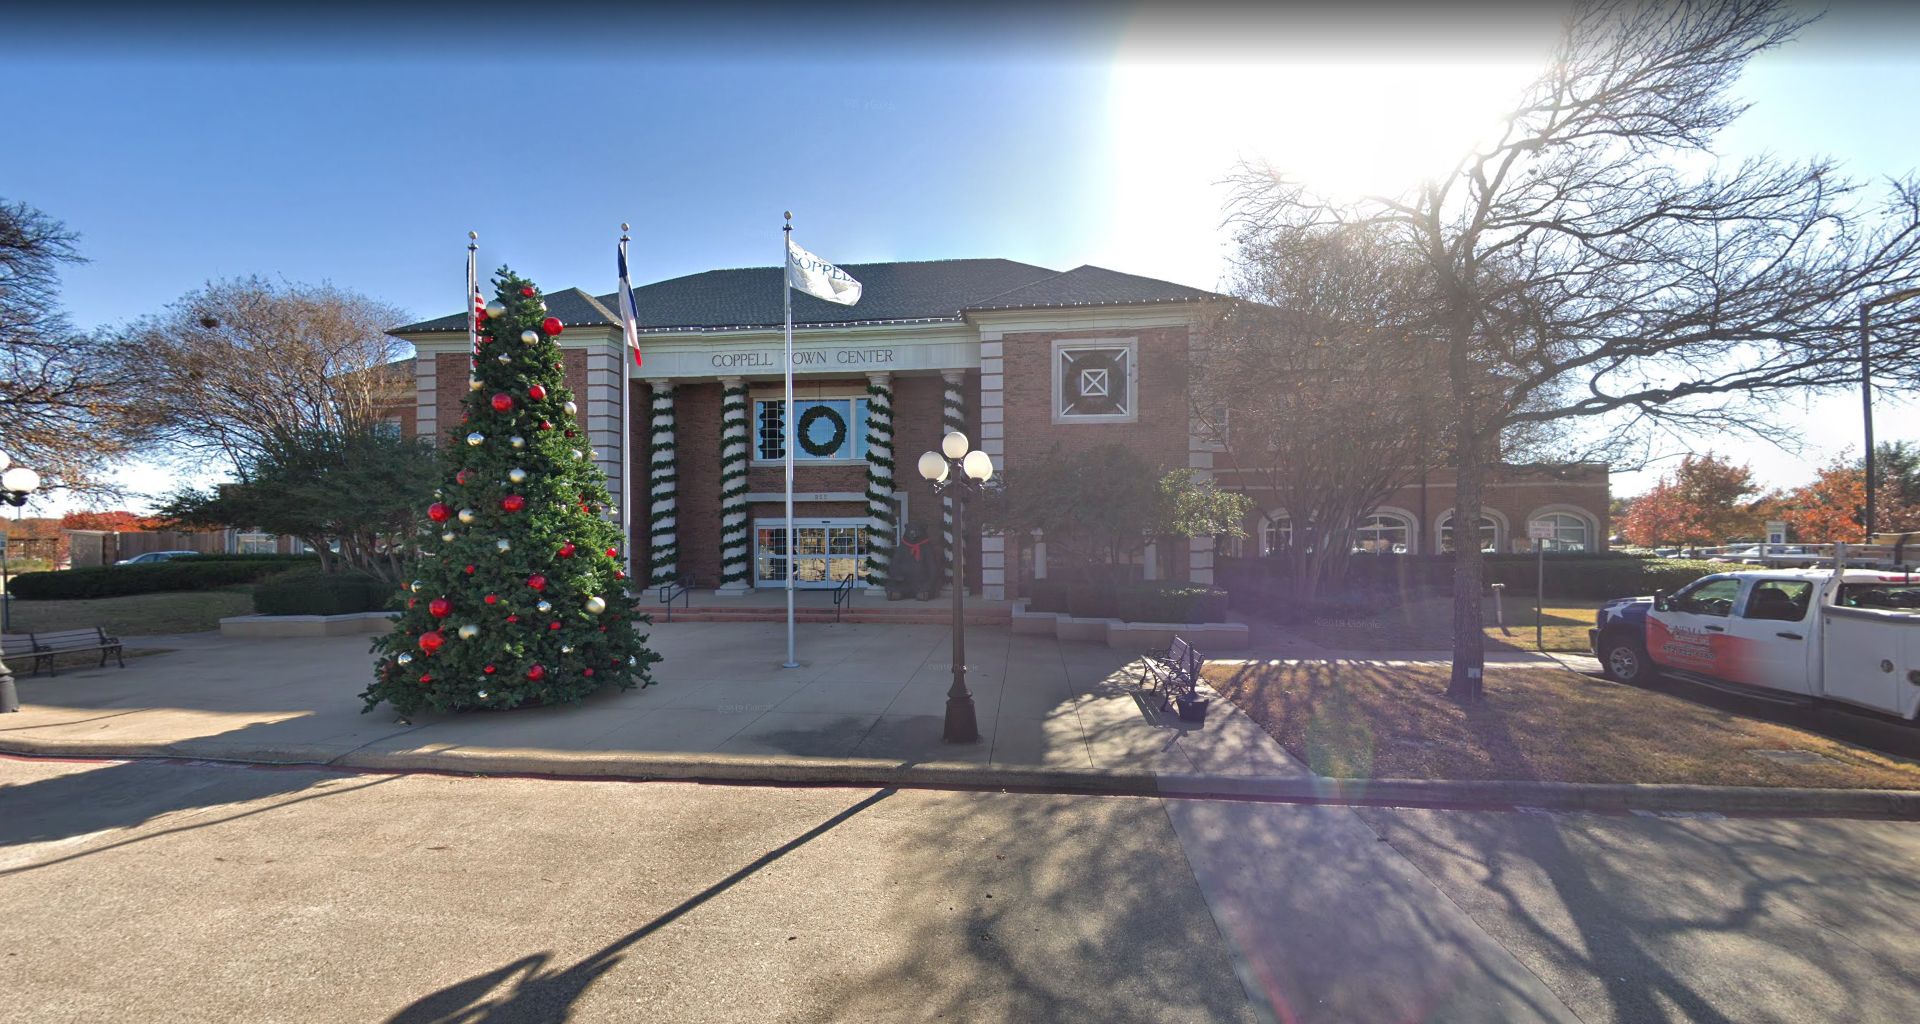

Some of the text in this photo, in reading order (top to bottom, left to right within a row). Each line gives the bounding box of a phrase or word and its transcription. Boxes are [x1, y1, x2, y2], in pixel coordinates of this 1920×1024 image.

[711, 349, 894, 367] COPPELL OWN CENTER
